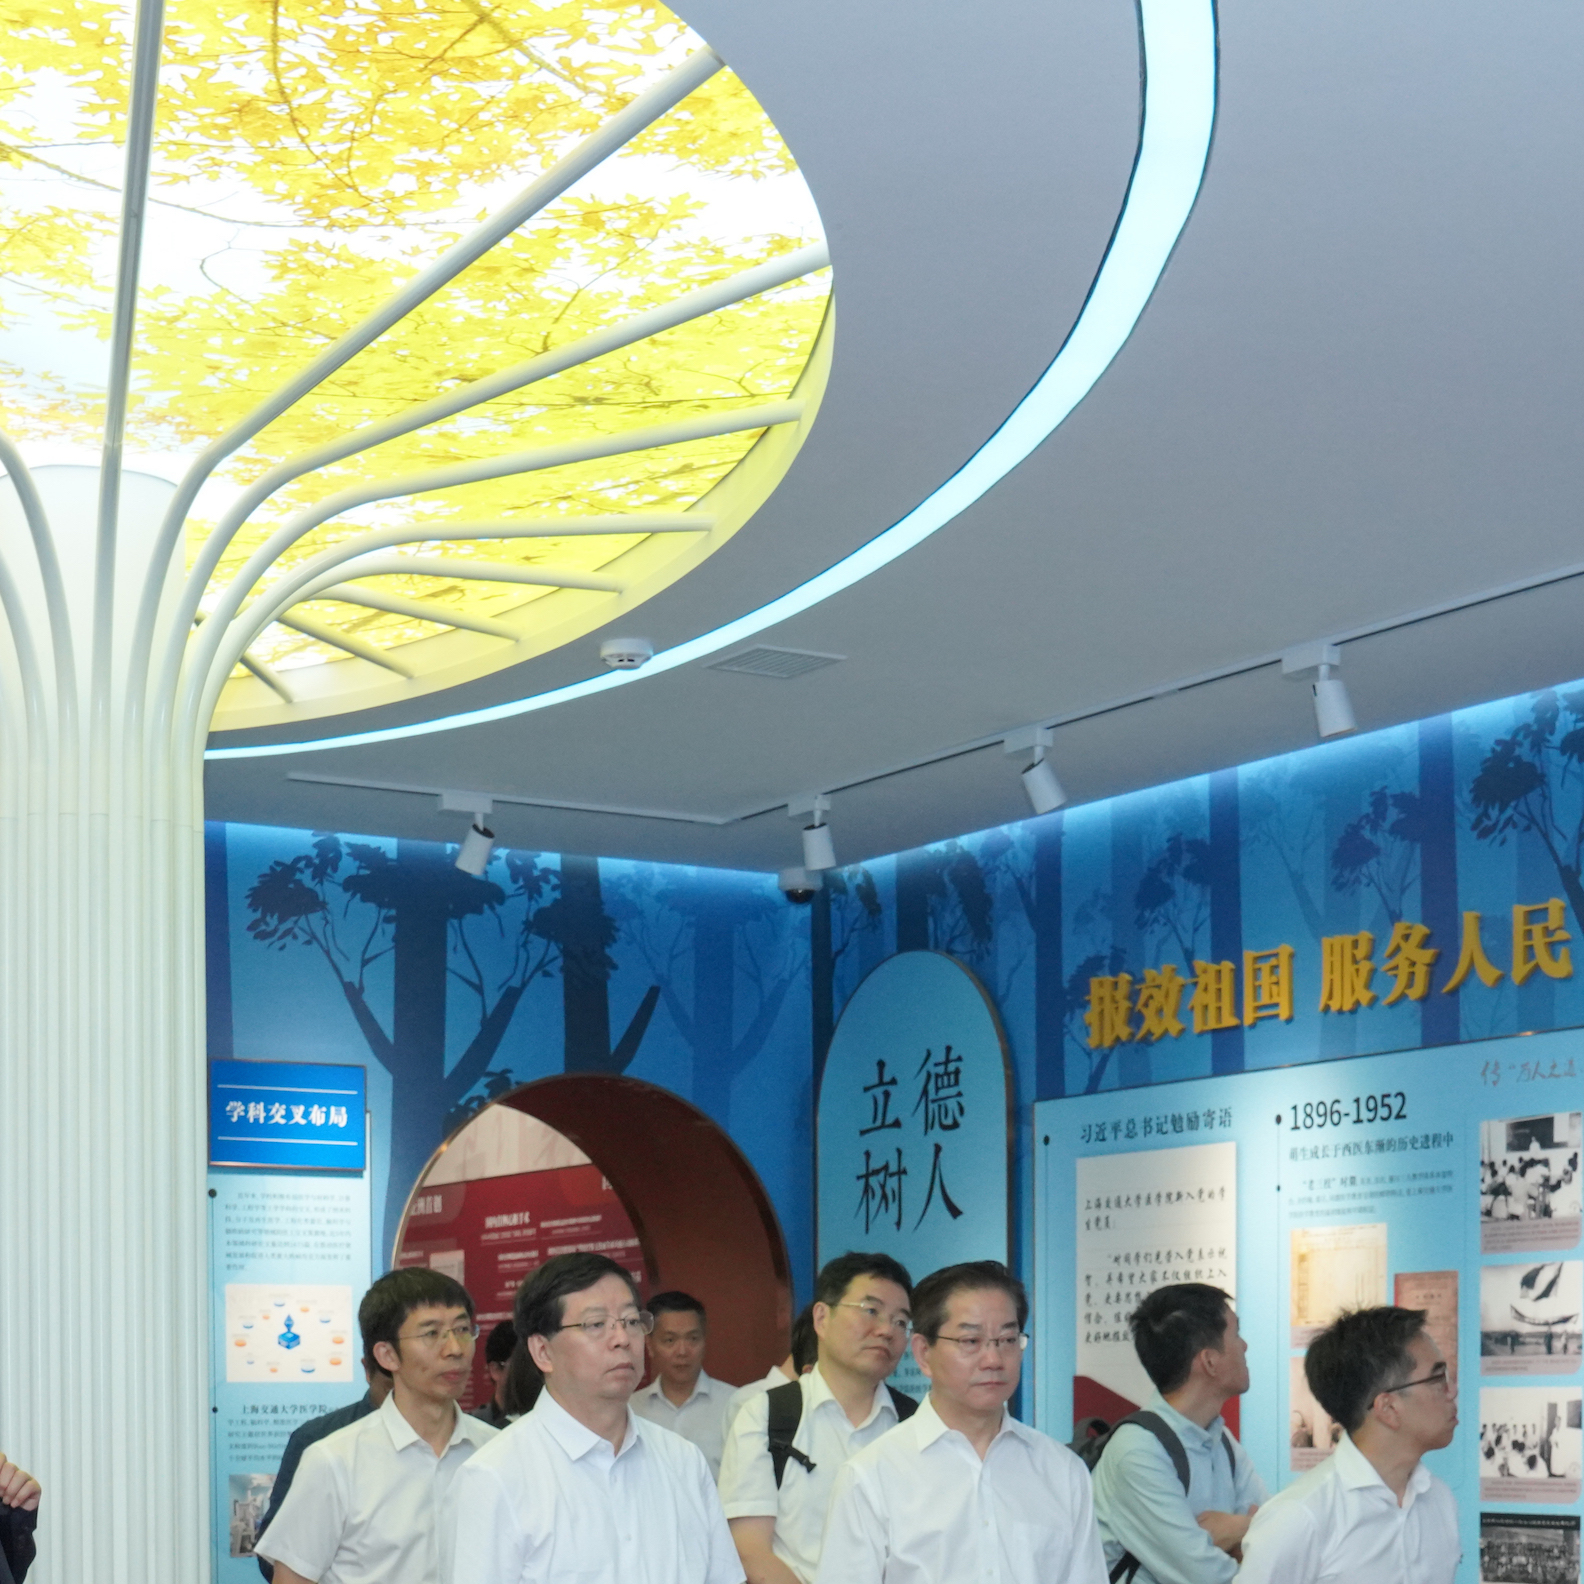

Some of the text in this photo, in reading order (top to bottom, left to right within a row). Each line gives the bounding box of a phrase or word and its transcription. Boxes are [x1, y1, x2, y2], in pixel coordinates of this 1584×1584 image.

[1083, 898, 1573, 1050] 报效祖国 服务人民
[225, 1100, 348, 1128] 学科交叉布局
[860, 1046, 965, 1137] 立德
[1290, 1092, 1407, 1131] 1896-1952
[1080, 1107, 1233, 1143] 习近平总书记勉励寄语
[854, 1143, 964, 1235] 树人
